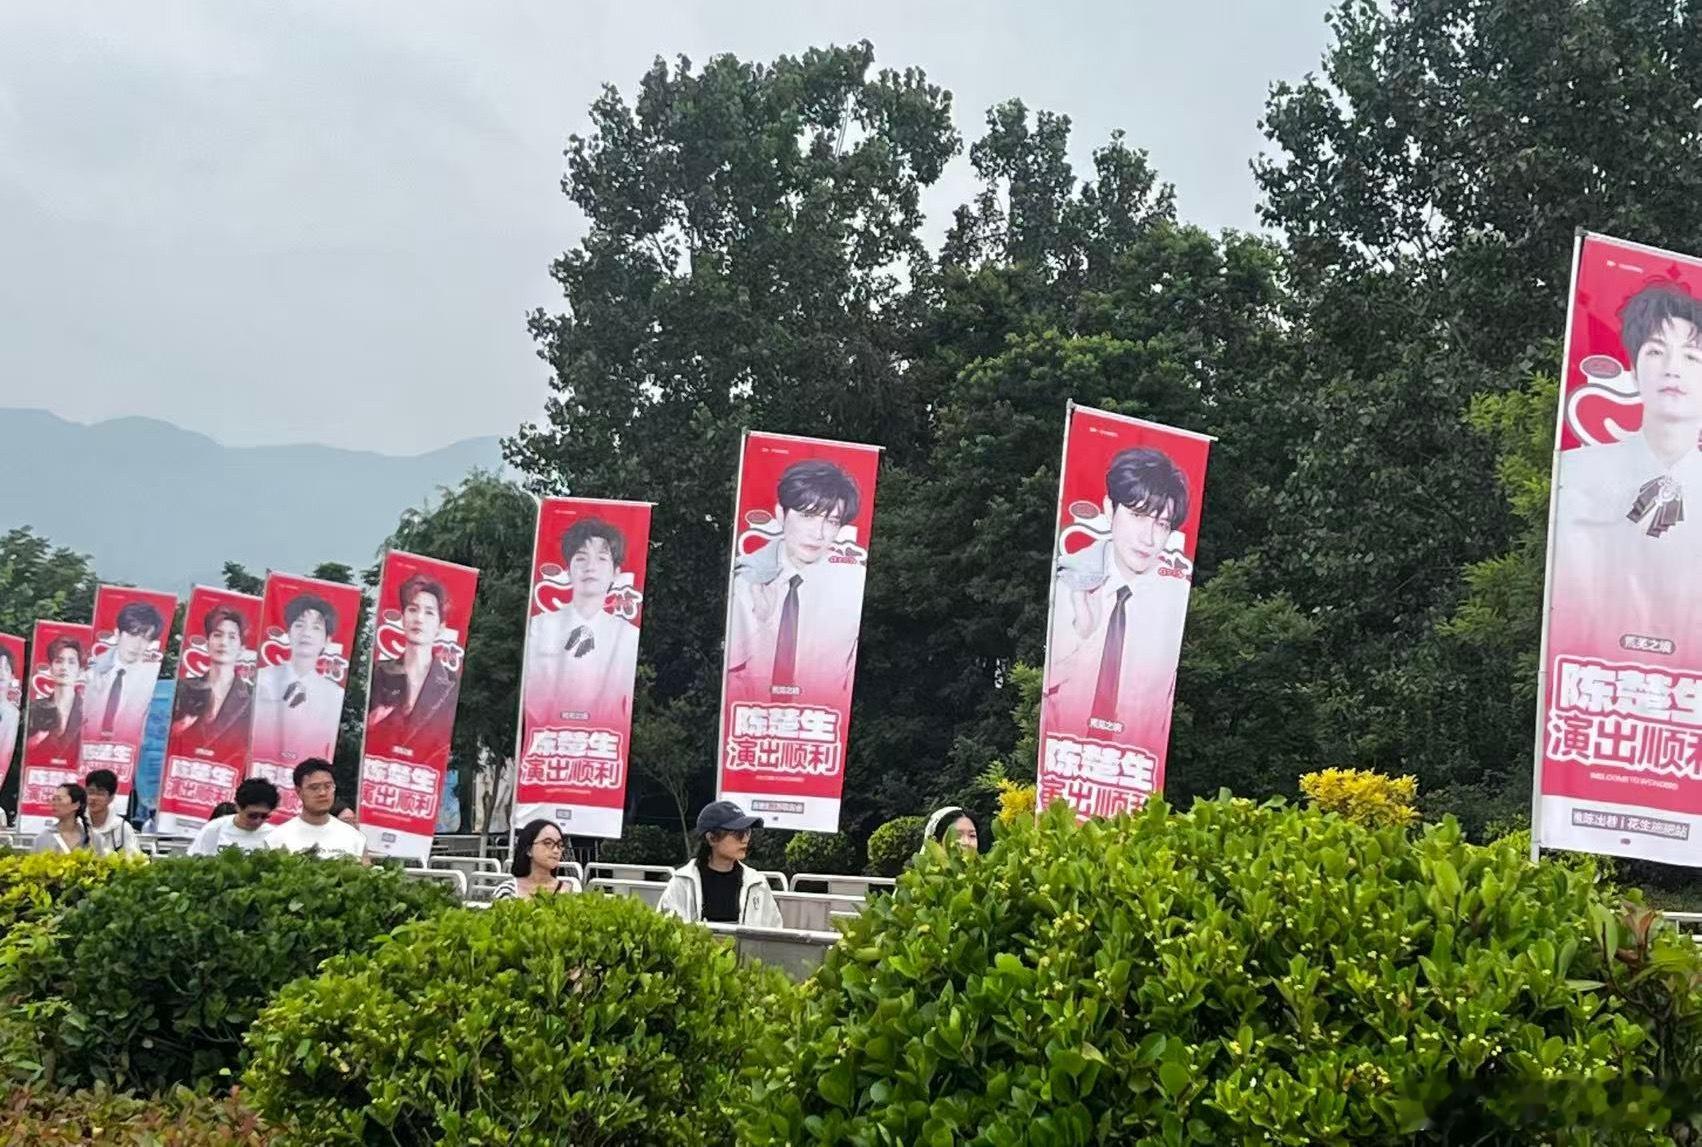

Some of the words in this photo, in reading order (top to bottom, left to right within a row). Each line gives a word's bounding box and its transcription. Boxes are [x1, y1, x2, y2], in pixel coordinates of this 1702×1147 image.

[1560, 662, 1702, 722] 陈楚生
[734, 705, 836, 742] 陈楚生
[528, 729, 618, 760] 陈楚生
[728, 738, 838, 773] 演出顺利
[172, 759, 235, 787] 陈楚生
[364, 758, 436, 793] 陈楚生
[521, 758, 620, 787] 演出顺利
[1045, 737, 1155, 793] 陈楚生
